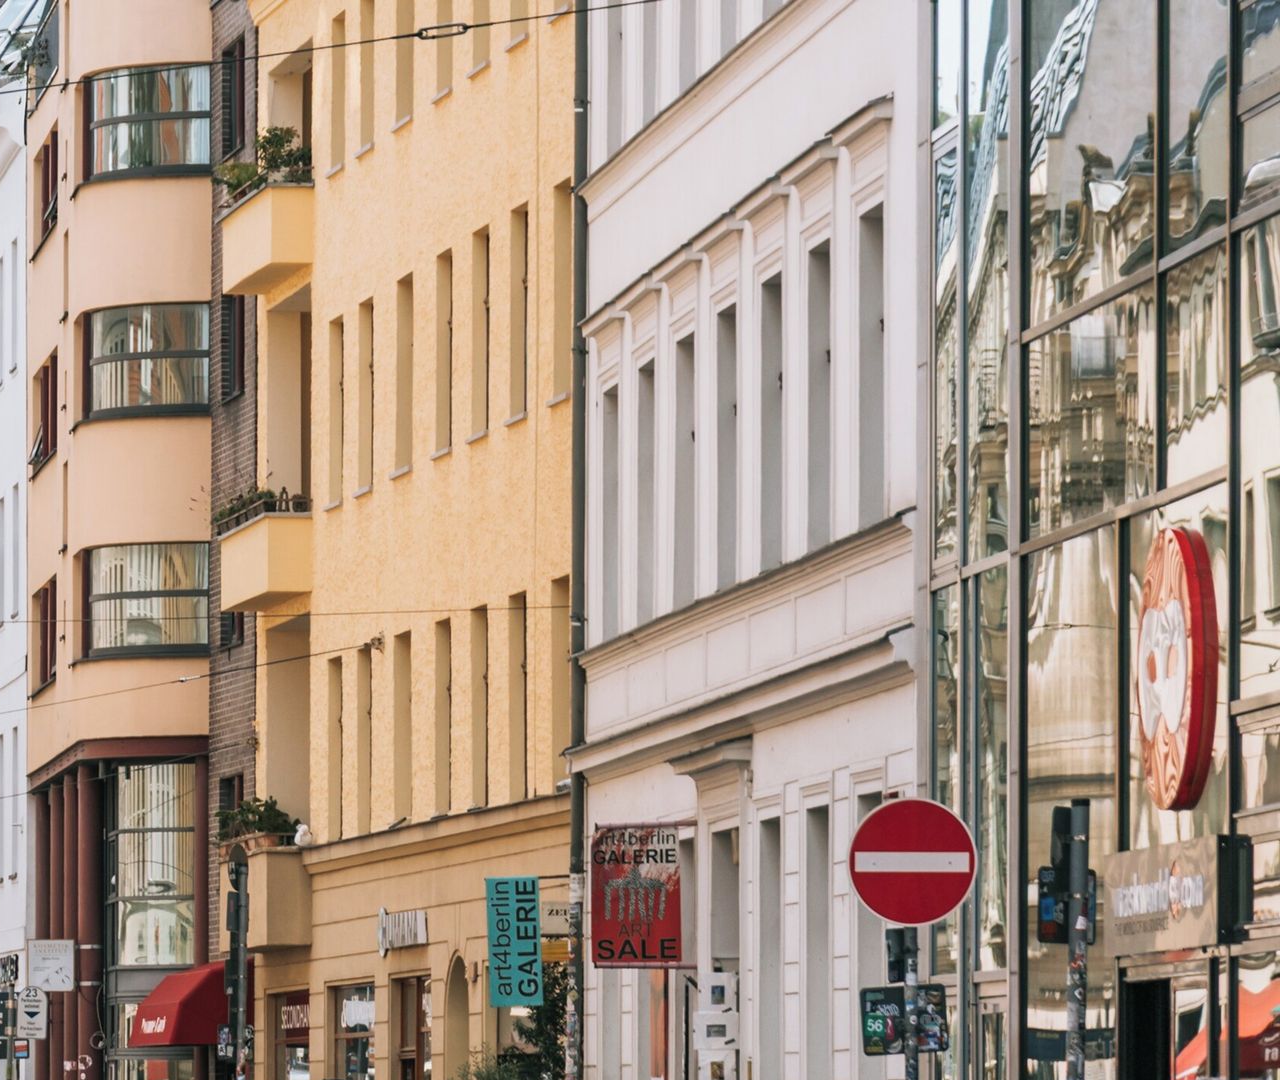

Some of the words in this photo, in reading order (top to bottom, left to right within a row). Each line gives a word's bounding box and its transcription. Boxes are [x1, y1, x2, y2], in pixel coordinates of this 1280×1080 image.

[595, 830, 677, 846] art4berlin
[593, 848, 677, 865] GALERIE
[618, 922, 652, 937] ART
[491, 880, 513, 996] art4berlin
[515, 880, 539, 998] GALERIE
[597, 938, 678, 960] SALE
[25, 988, 38, 998] 23
[867, 1019, 884, 1032] 56
